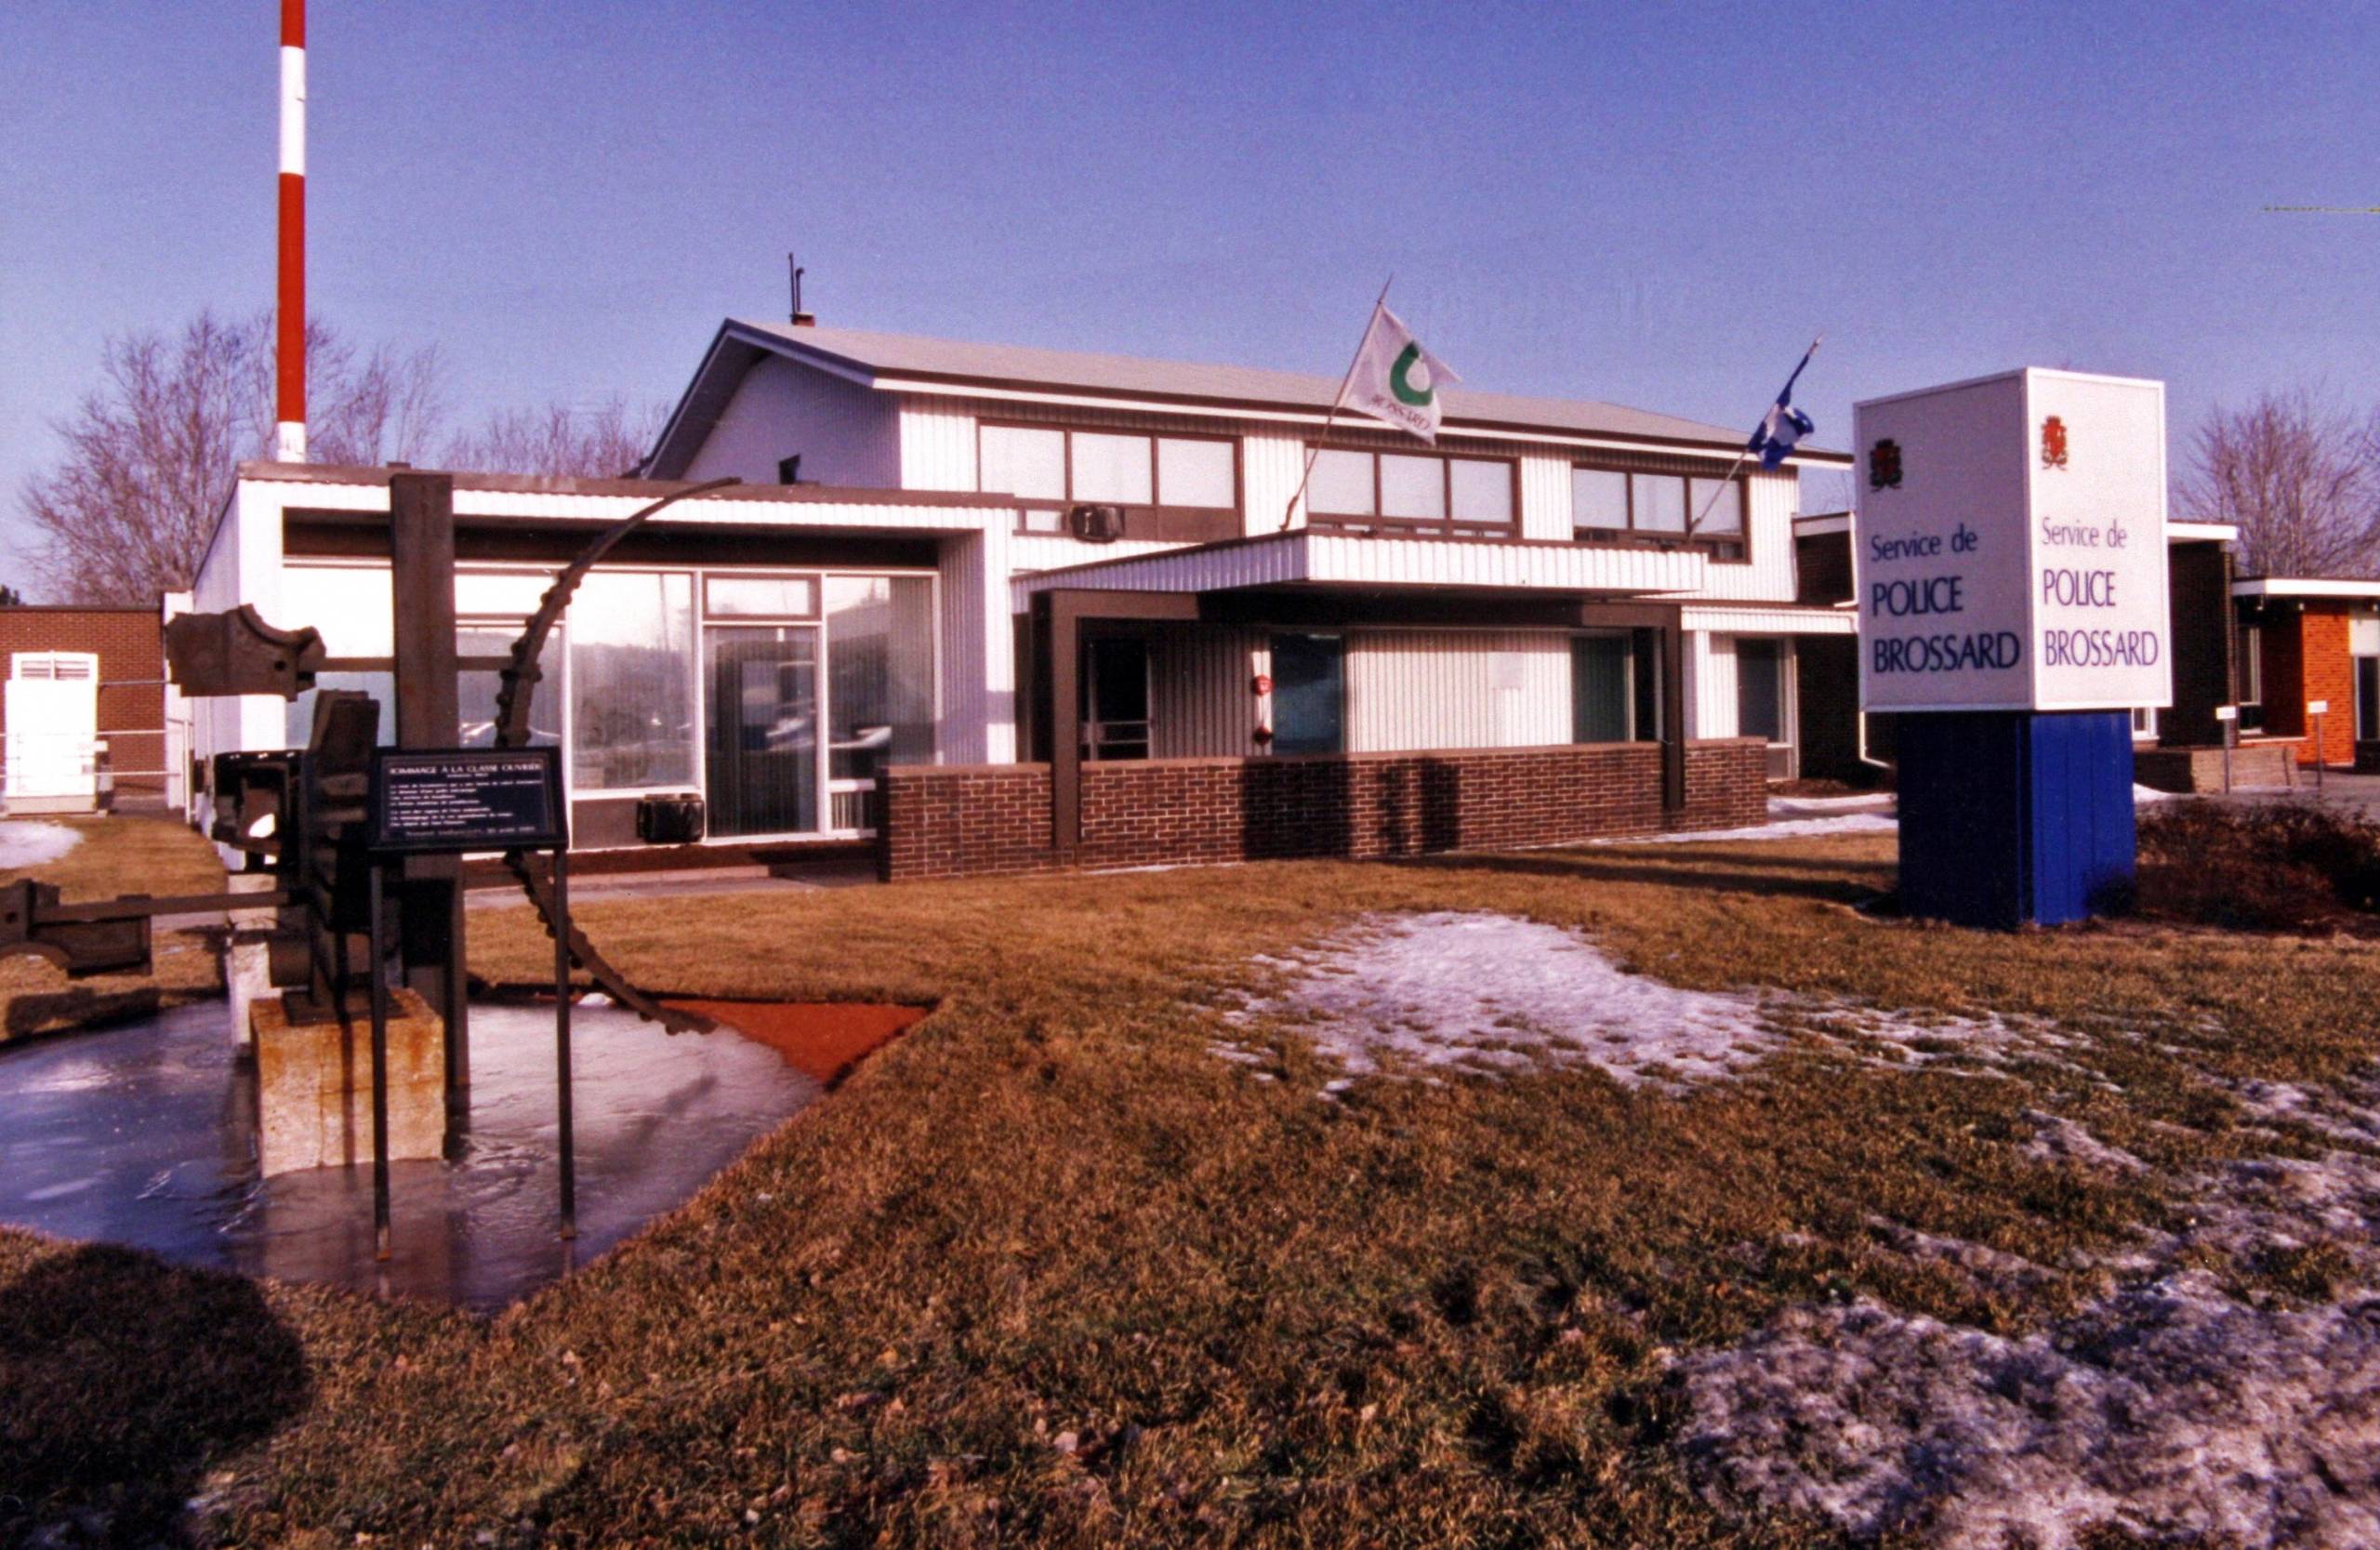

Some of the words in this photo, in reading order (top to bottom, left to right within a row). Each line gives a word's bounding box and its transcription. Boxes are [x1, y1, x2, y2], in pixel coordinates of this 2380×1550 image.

[1871, 530, 1942, 563] Service
[1950, 523, 1978, 554] de
[2042, 516, 2100, 548] Service
[2106, 518, 2129, 549] de
[1871, 575, 1964, 617] POLICE
[2043, 568, 2117, 608] POLICE
[1873, 630, 2021, 674] BROSSARD
[2044, 629, 2159, 668] BROSSARD
